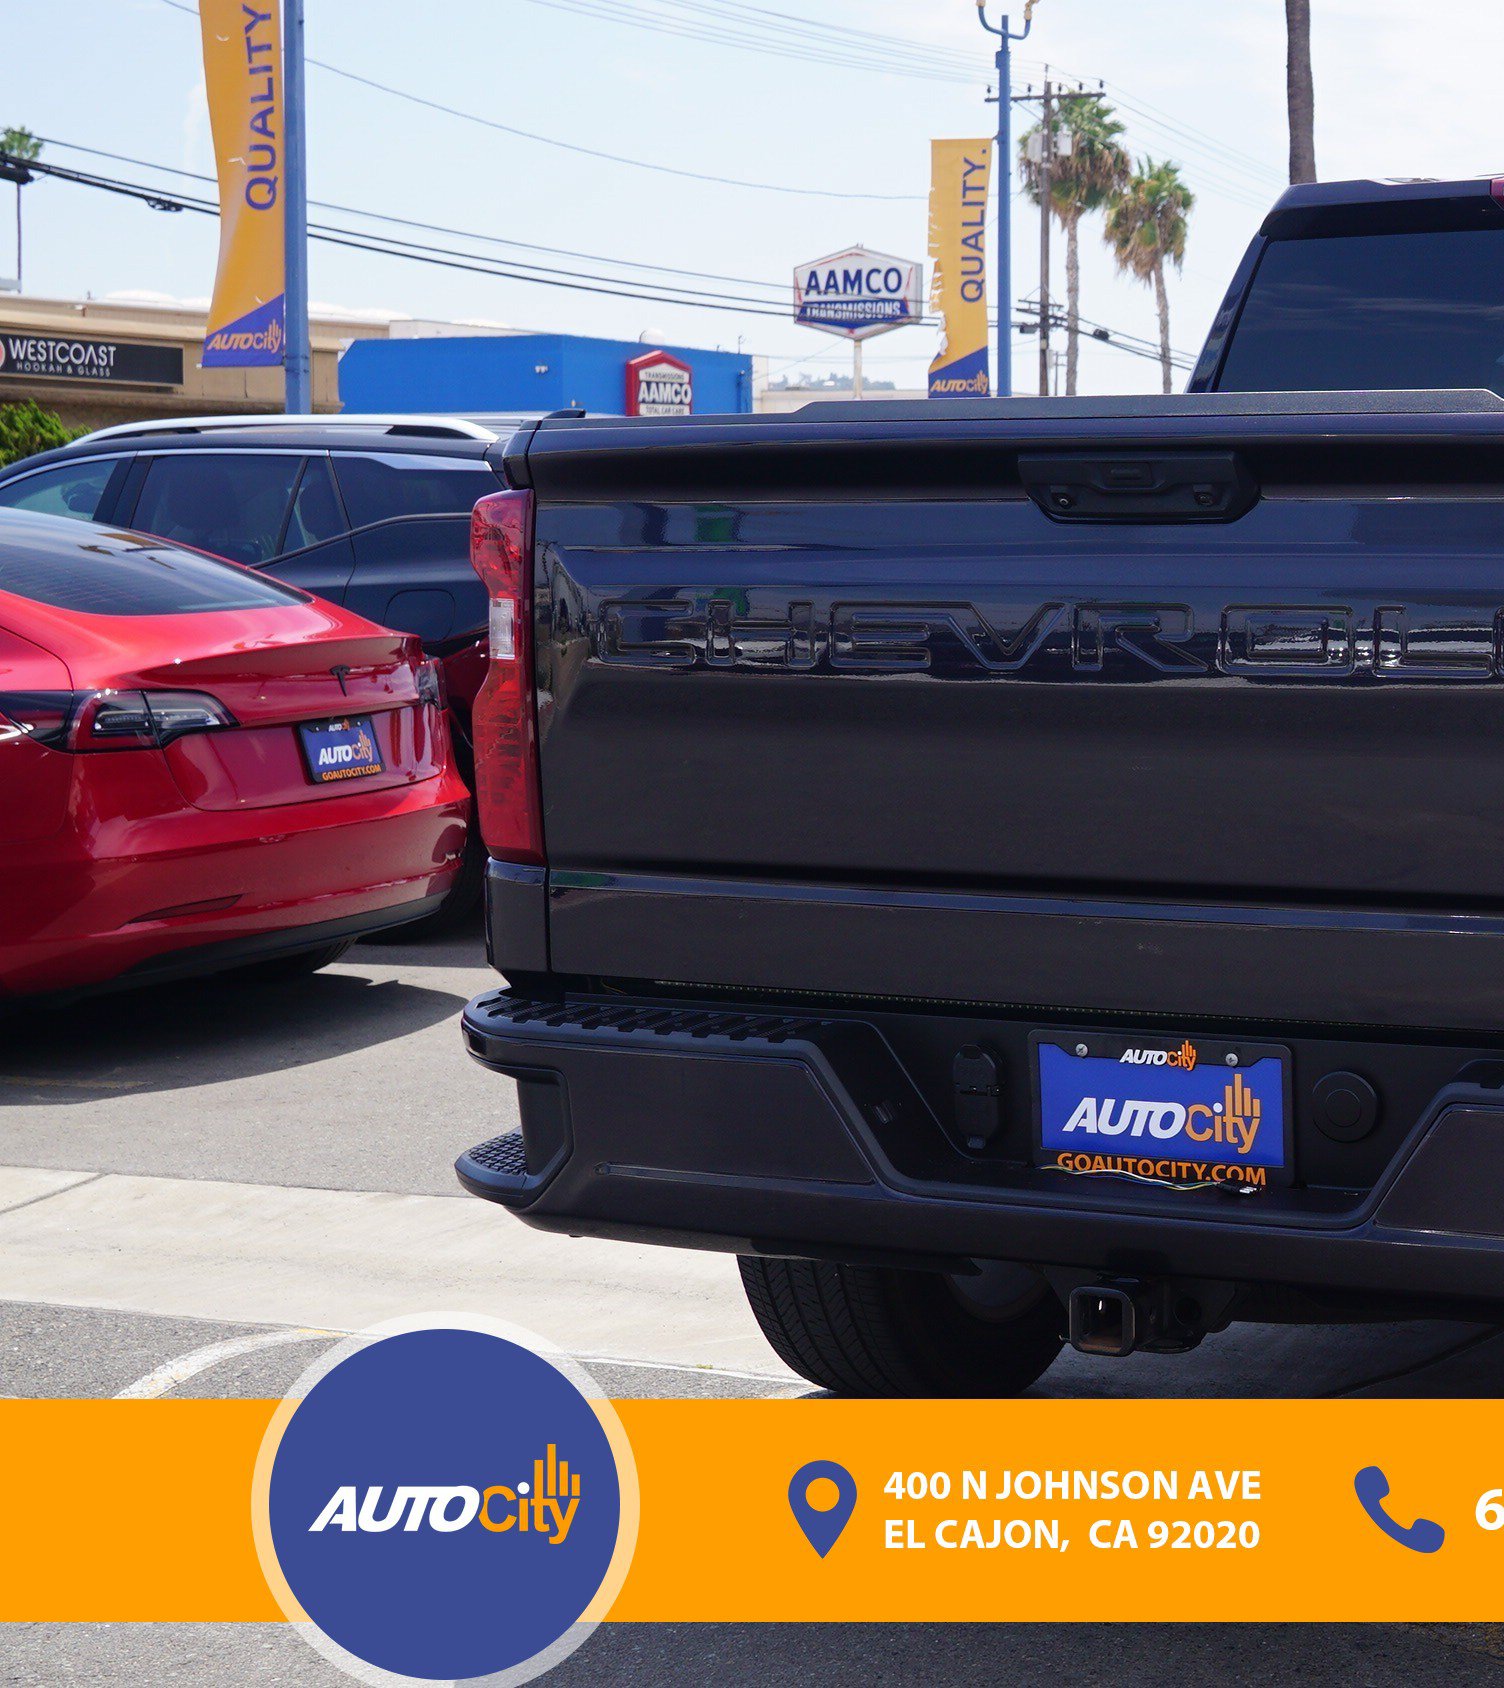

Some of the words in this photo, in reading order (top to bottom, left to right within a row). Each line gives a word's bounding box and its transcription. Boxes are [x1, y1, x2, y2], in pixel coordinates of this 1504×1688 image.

[242, 4, 278, 211] QUALITY
[960, 149, 986, 303] QUALITY.
[805, 267, 902, 296] AAMCO
[806, 300, 900, 319] TRANSMISSIONS
[8, 337, 116, 367] WESTCOAST
[16, 361, 62, 373] HOOKAH
[66, 366, 73, 375] &
[77, 367, 111, 377] GLASS
[638, 381, 692, 404] AAMCO
[322, 764, 381, 780] GOAUTOCITY.COM
[1057, 1152, 1266, 1186] GOAUTOCITY.COM
